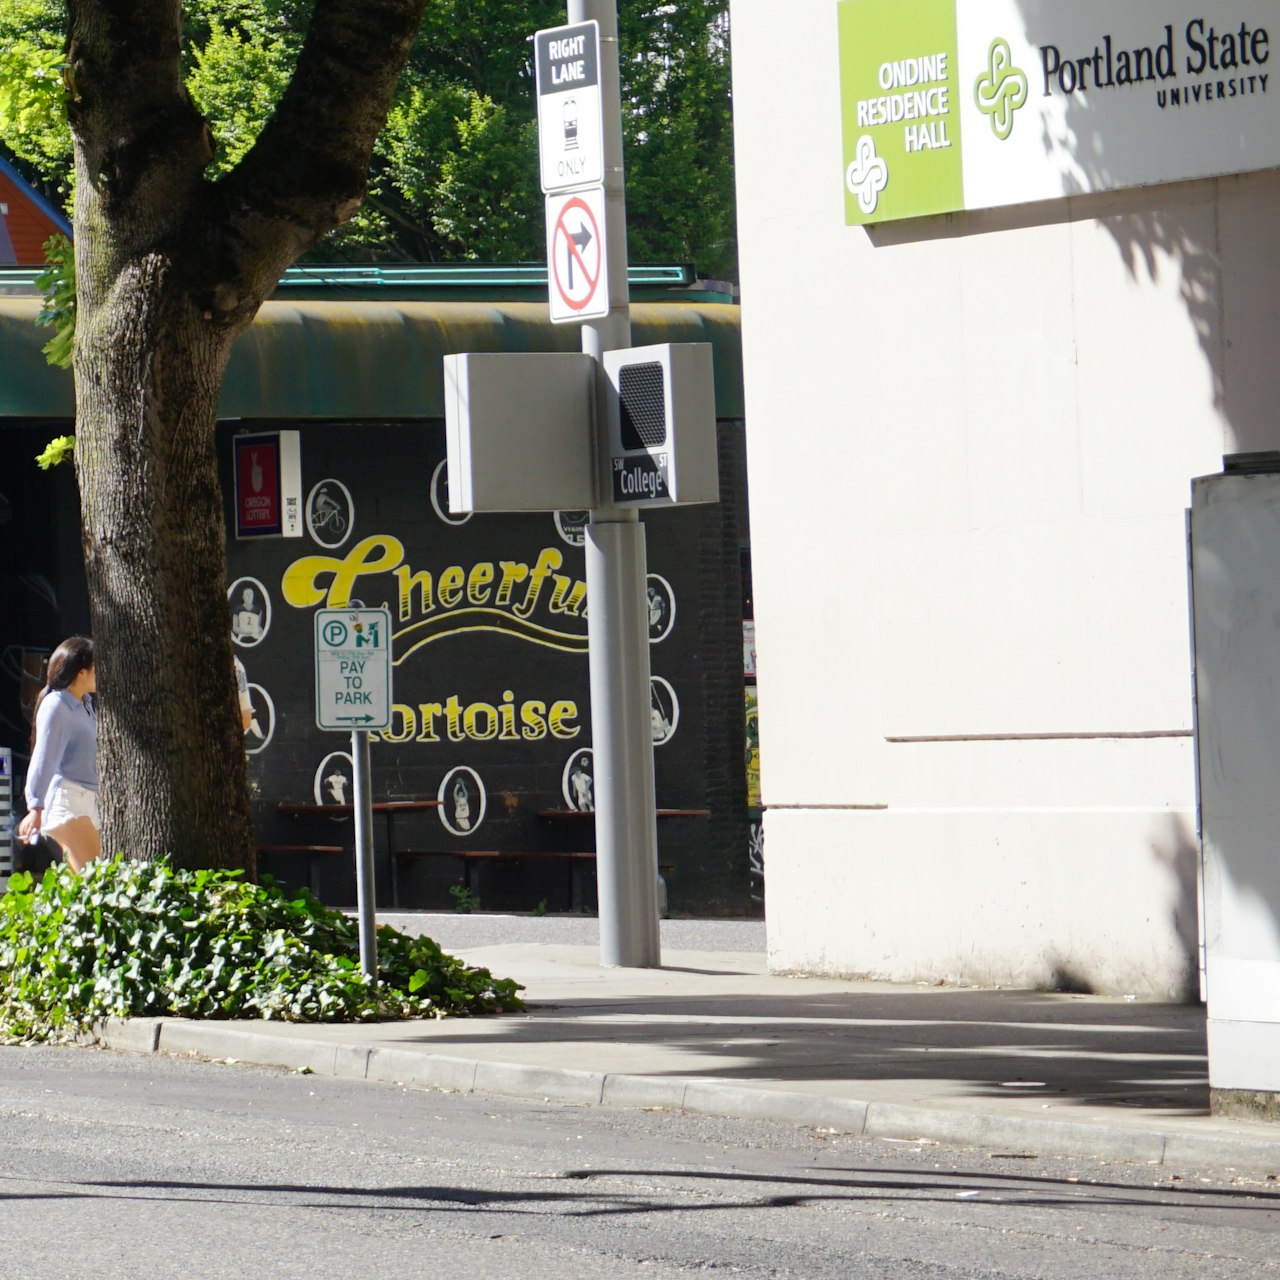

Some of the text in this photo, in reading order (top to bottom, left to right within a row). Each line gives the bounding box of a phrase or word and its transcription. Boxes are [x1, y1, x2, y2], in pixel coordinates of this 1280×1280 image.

[549, 35, 585, 60] RIGHT
[1040, 19, 1270, 97] Portland State
[551, 60, 585, 84] LANE
[879, 53, 948, 90] ONDINE
[1157, 74, 1269, 109] UNIVERSITY
[857, 86, 949, 128] RESIDENCE
[904, 120, 952, 153] HALL
[558, 158, 585, 176] ONLY
[613, 454, 668, 471] SW ST
[621, 467, 663, 498] College
[245, 496, 271, 508] OREGON
[563, 525, 585, 533] VIKIN
[282, 535, 589, 622] Cheerfu
[340, 661, 366, 674] PAY
[344, 676, 362, 690] TO
[335, 692, 372, 705] PARK
[351, 690, 581, 743] ortoise
